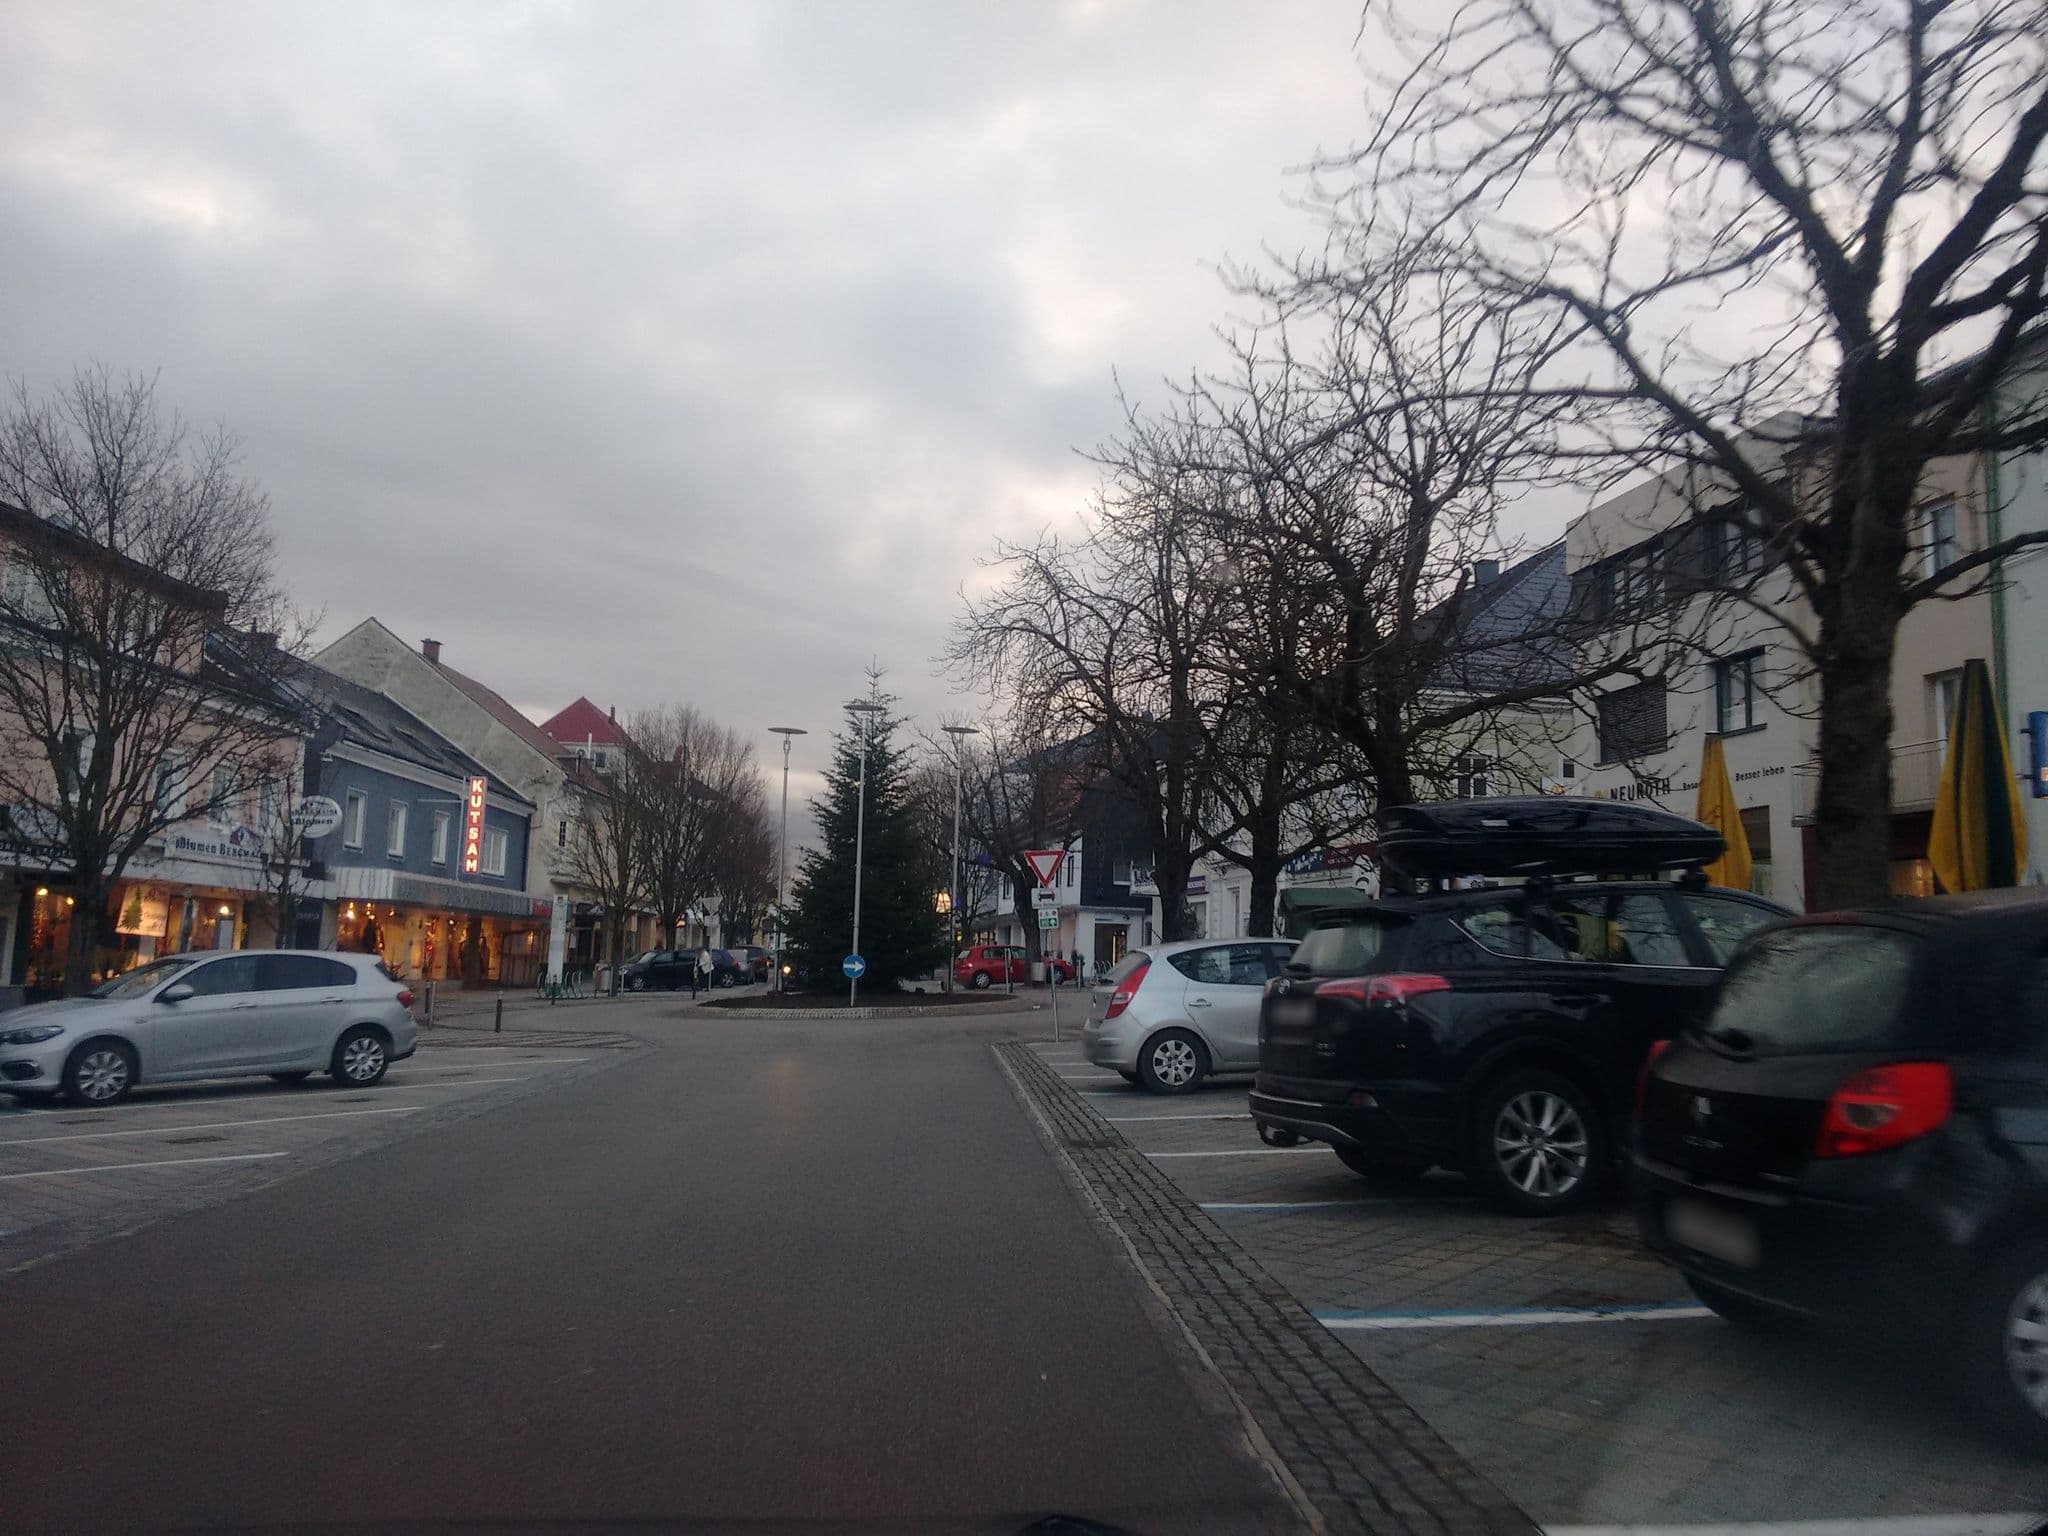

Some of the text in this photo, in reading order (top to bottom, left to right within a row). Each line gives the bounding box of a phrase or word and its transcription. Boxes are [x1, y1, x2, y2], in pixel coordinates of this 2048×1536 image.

[1735, 770, 1760, 782] Besser
[1762, 766, 1785, 777] leben
[1610, 777, 1670, 801] NEUROTH
[466, 779, 483, 872] KUTSAM
[176, 836, 268, 859] Blumen BERGMA
